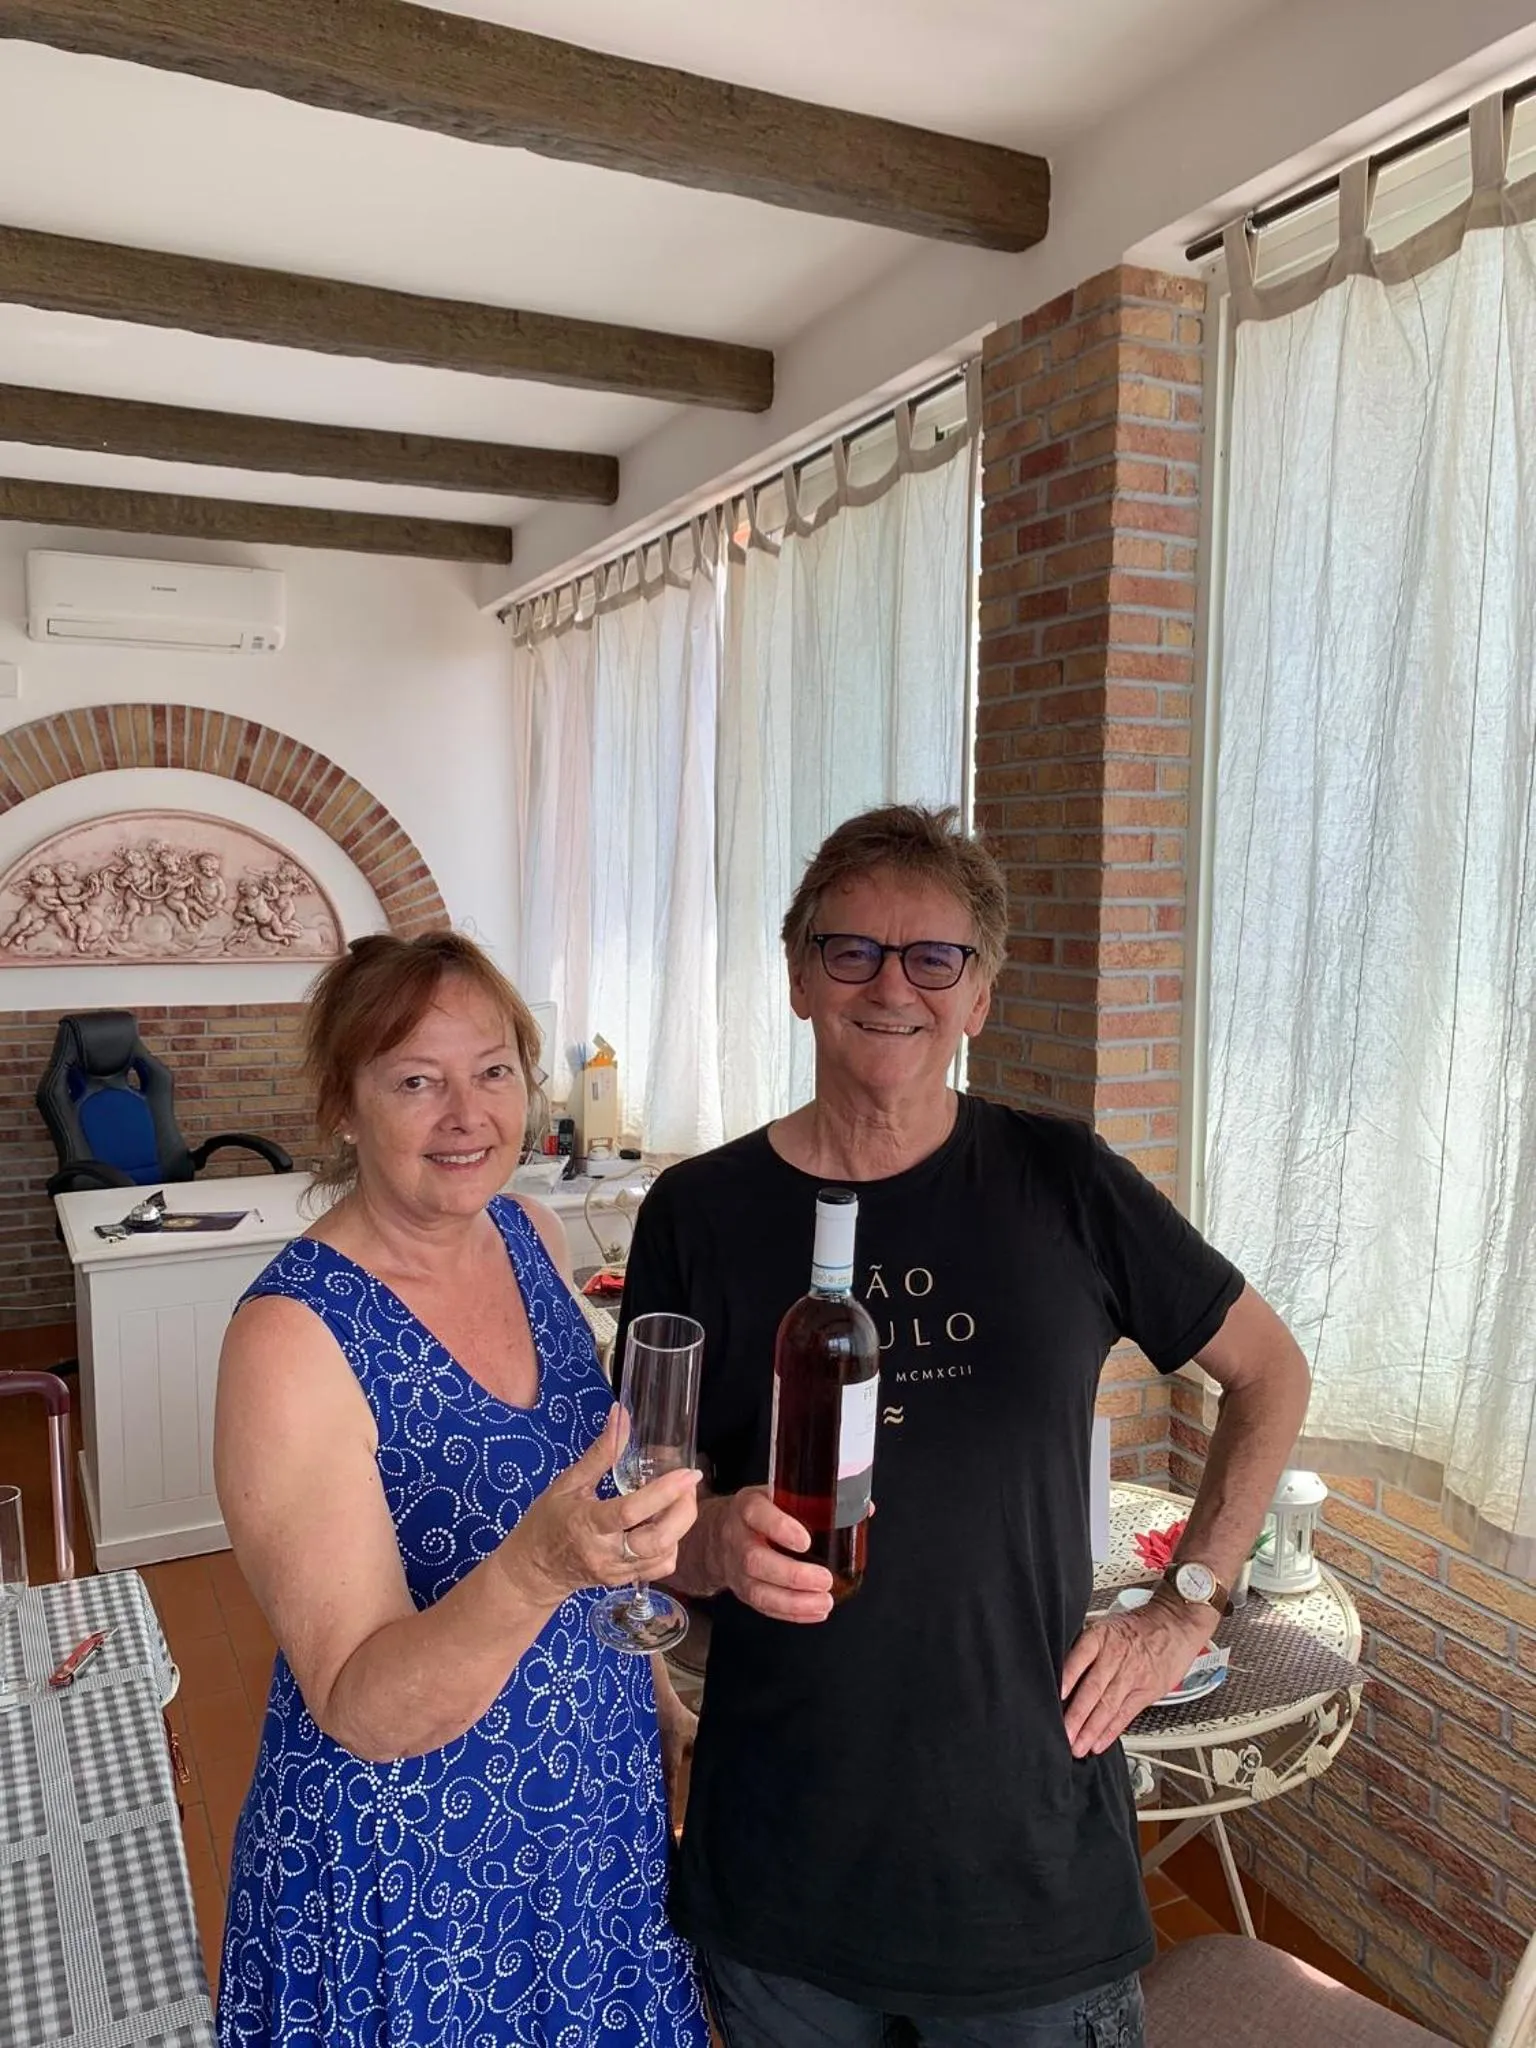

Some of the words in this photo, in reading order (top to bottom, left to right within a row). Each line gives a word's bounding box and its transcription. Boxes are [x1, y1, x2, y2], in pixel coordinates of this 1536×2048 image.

[866, 1264, 933, 1299] ÃO
[878, 1312, 975, 1350] ULO
[896, 1365, 972, 1383] MCMXCII
